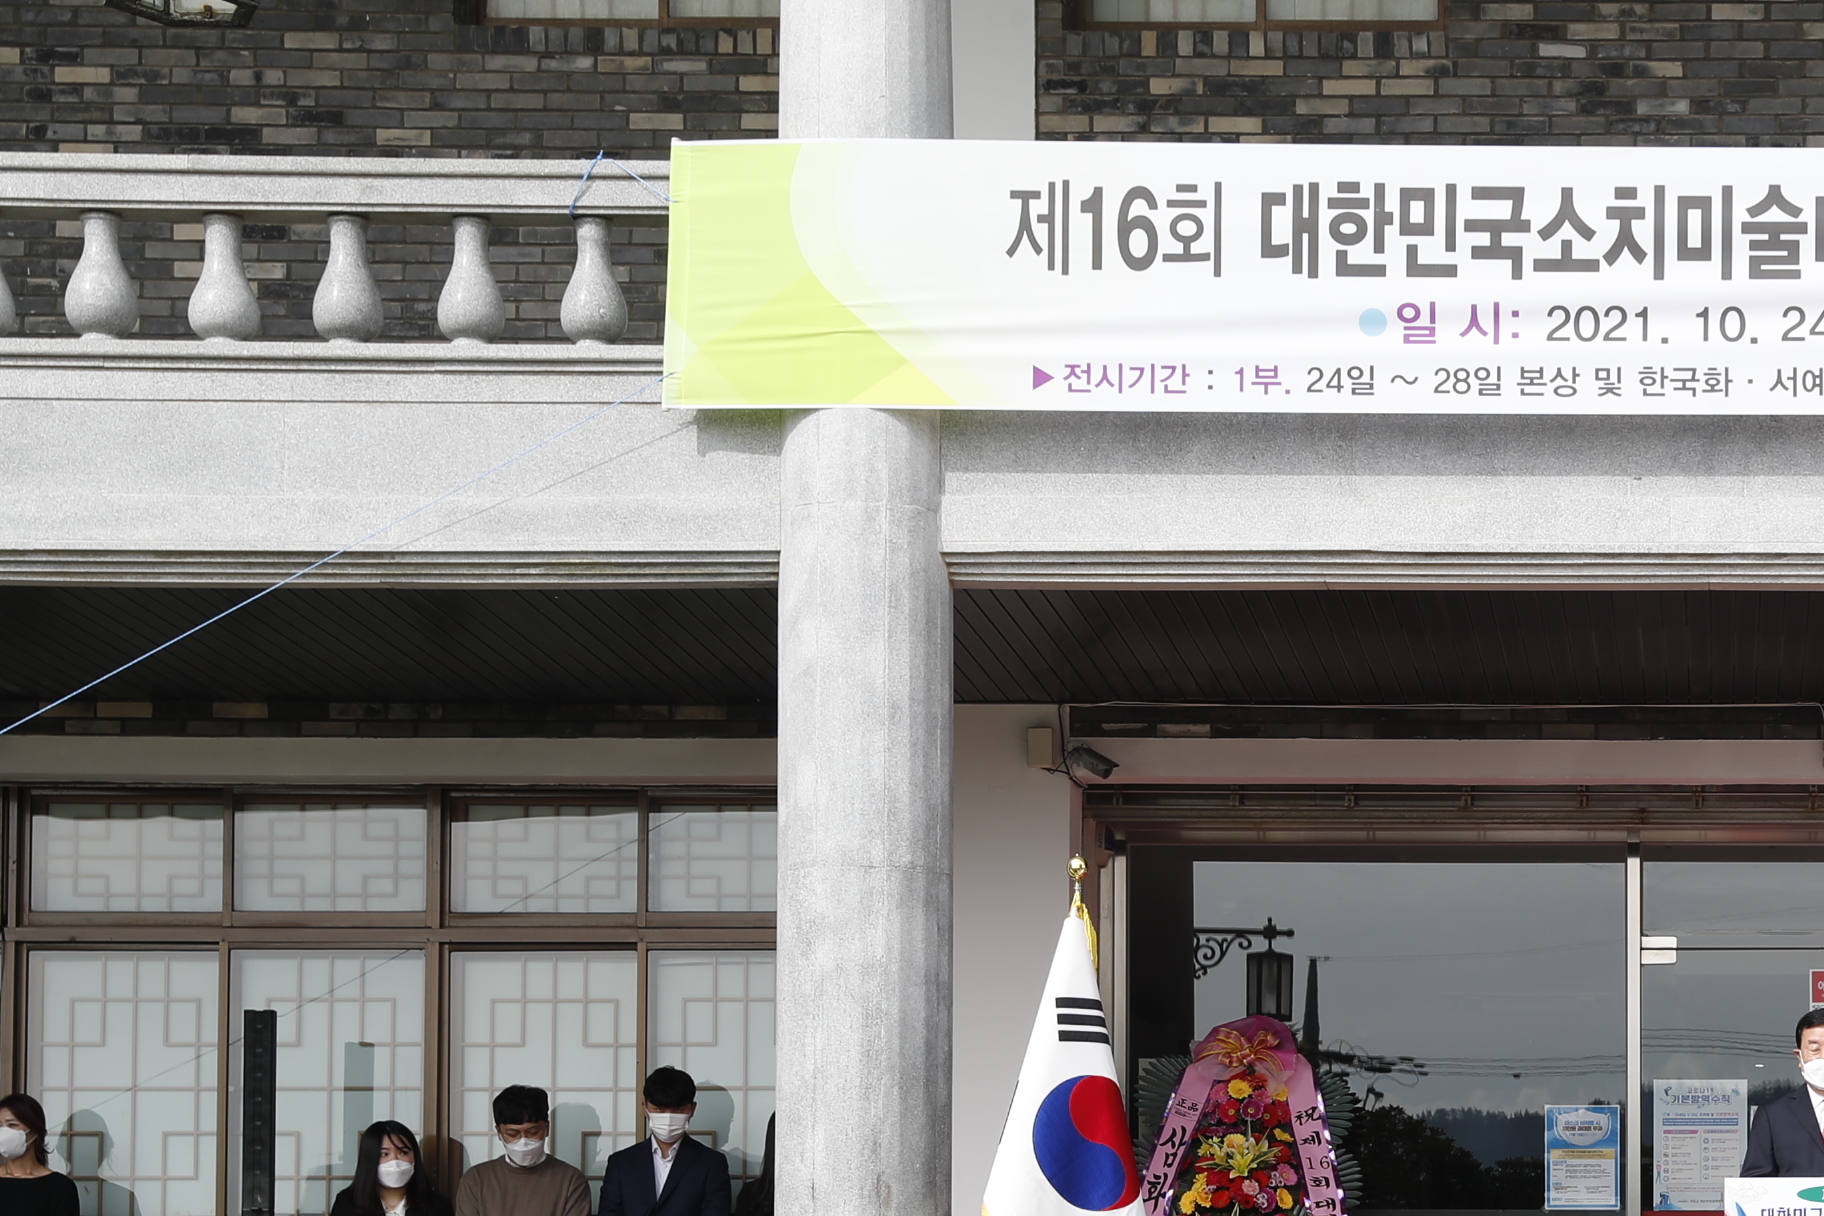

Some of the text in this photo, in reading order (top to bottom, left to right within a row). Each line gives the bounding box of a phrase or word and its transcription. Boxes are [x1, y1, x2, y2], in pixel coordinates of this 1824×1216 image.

[1005, 178, 1224, 278] 제16회
[1395, 301, 1438, 345] 일
[1545, 305, 1670, 345] 2021.
[1695, 305, 1759, 345] 10.
[1065, 364, 1191, 396] 전시기간
[1235, 366, 1291, 396] 1부.
[1308, 367, 1376, 397] 24일
[1435, 367, 1502, 398] 28일
[1517, 368, 1581, 398] 본상
[1596, 368, 1622, 398] 및
[1640, 368, 1734, 398] 한국화
